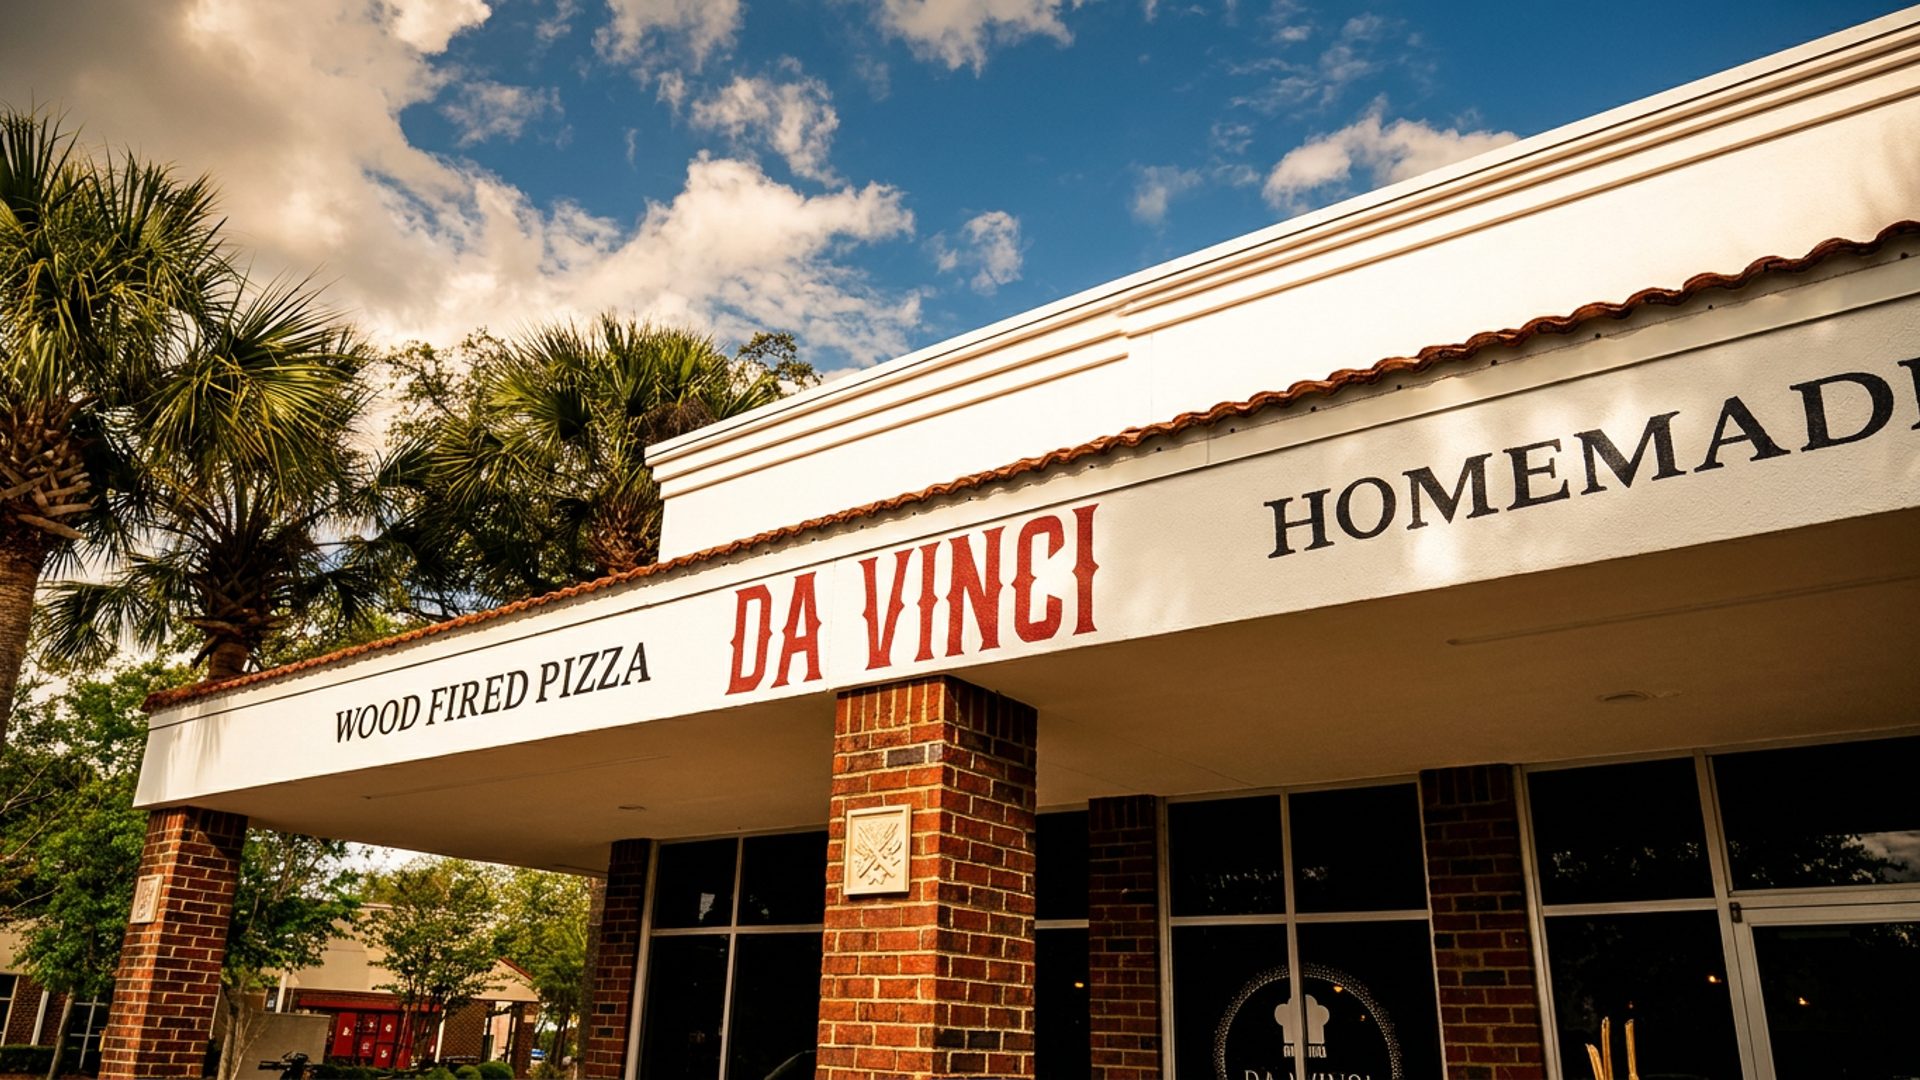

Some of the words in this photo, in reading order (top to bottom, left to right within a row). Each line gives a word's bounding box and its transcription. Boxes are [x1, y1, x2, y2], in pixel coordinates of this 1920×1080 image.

[726, 572, 822, 696] DA
[859, 503, 1099, 671] VINCI
[336, 695, 420, 743] WOOD
[426, 670, 529, 726] FIRED
[536, 642, 651, 703] PIZZA
